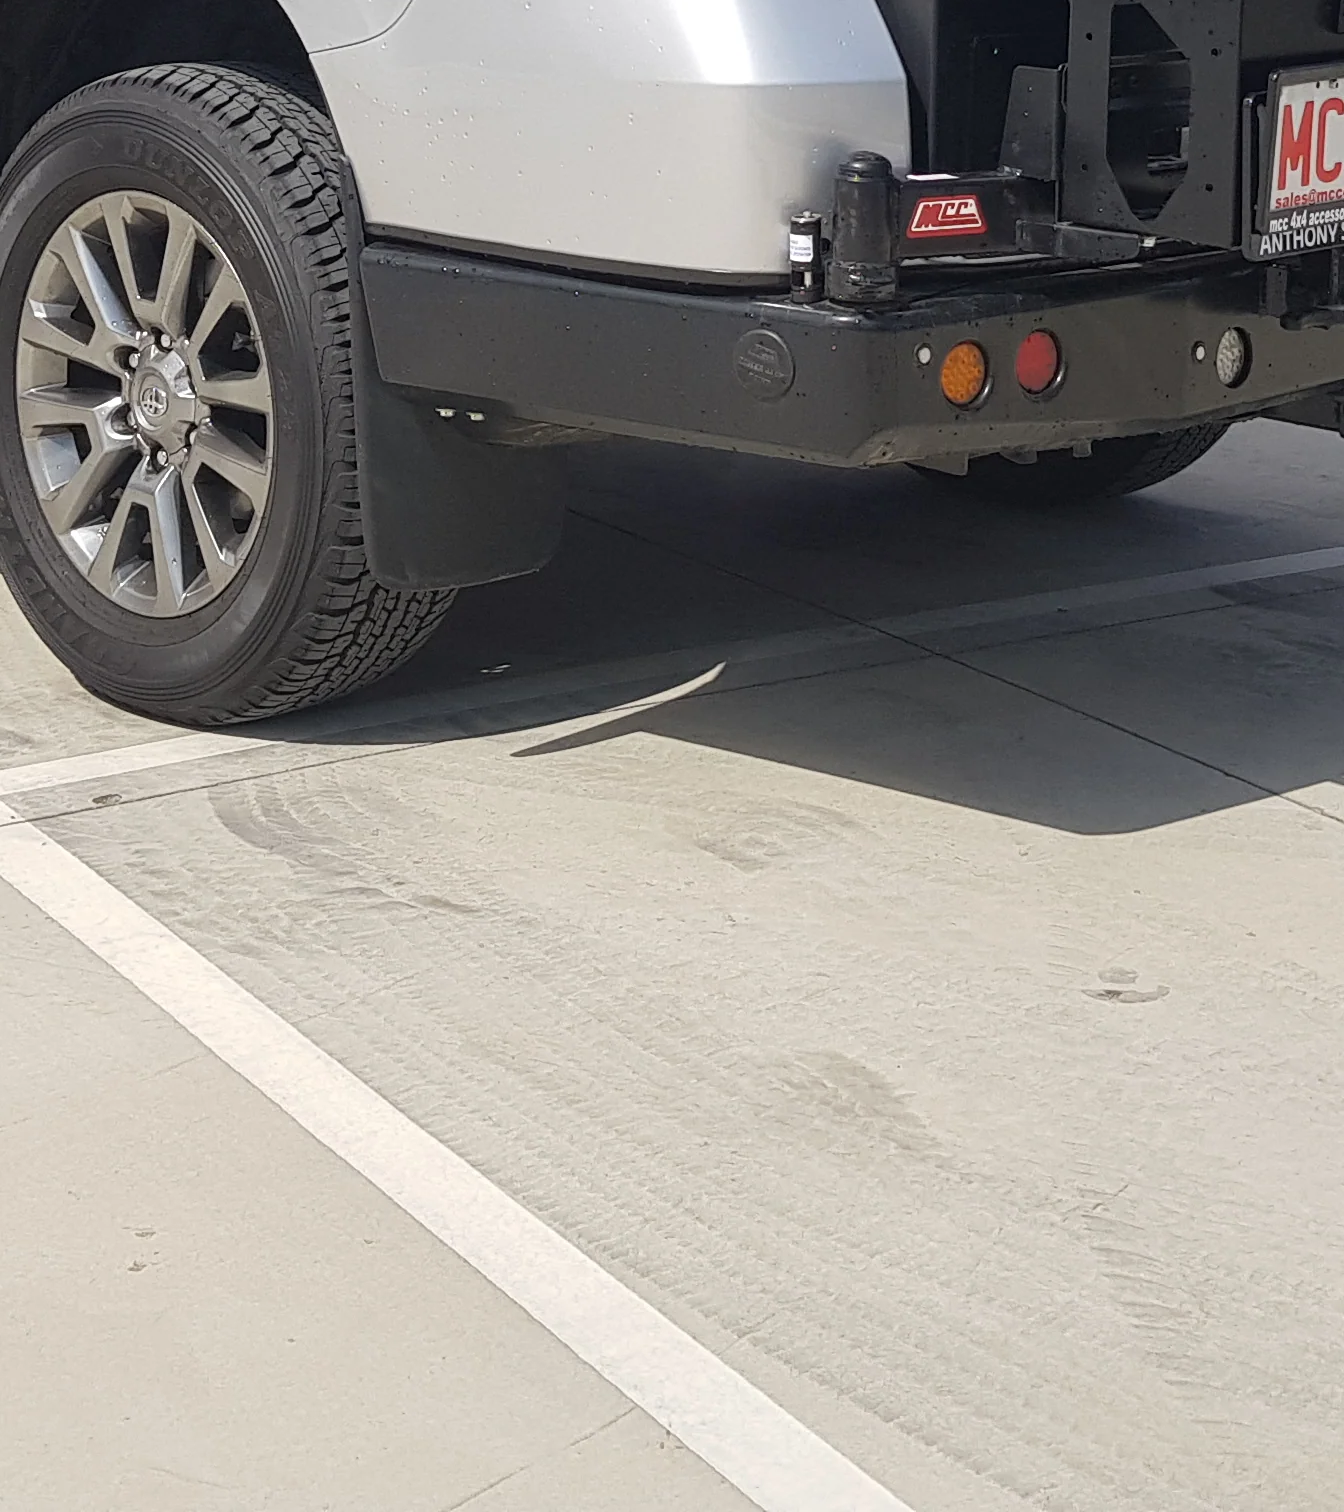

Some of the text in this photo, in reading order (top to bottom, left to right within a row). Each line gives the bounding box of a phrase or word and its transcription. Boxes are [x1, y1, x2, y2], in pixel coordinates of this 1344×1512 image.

[1269, 217, 1289, 233] mcc
[1289, 209, 1308, 229] 4x4
[1259, 223, 1338, 256] ANTHONY
